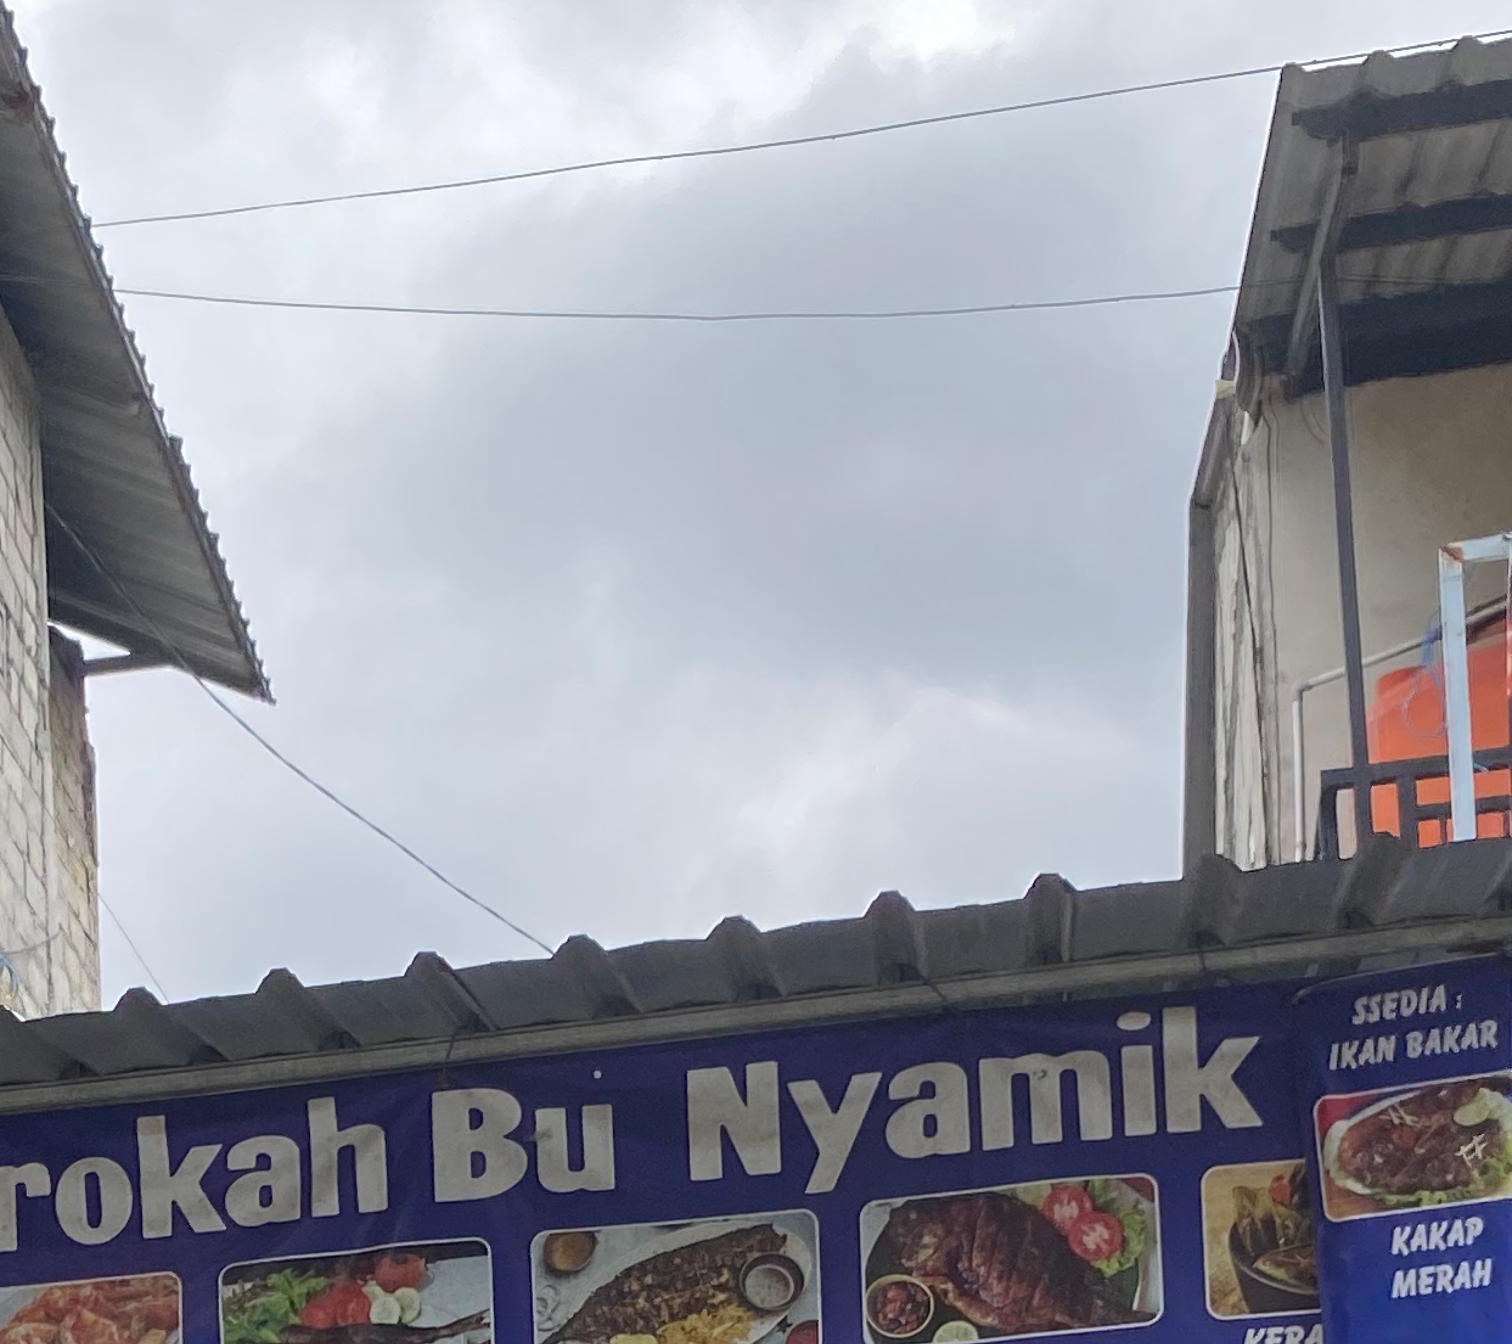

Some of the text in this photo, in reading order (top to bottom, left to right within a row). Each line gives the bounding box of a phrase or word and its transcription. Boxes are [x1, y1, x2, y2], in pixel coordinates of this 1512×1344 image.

[1352, 984, 1447, 1025] SSEDIA
[1329, 1019, 1498, 1071] IKAN BAKAR
[431, 1087, 615, 1202] Bu
[687, 1006, 1263, 1195] Nyamik
[1391, 1216, 1484, 1256] KAKAP
[1391, 1257, 1492, 1299] MERAH
